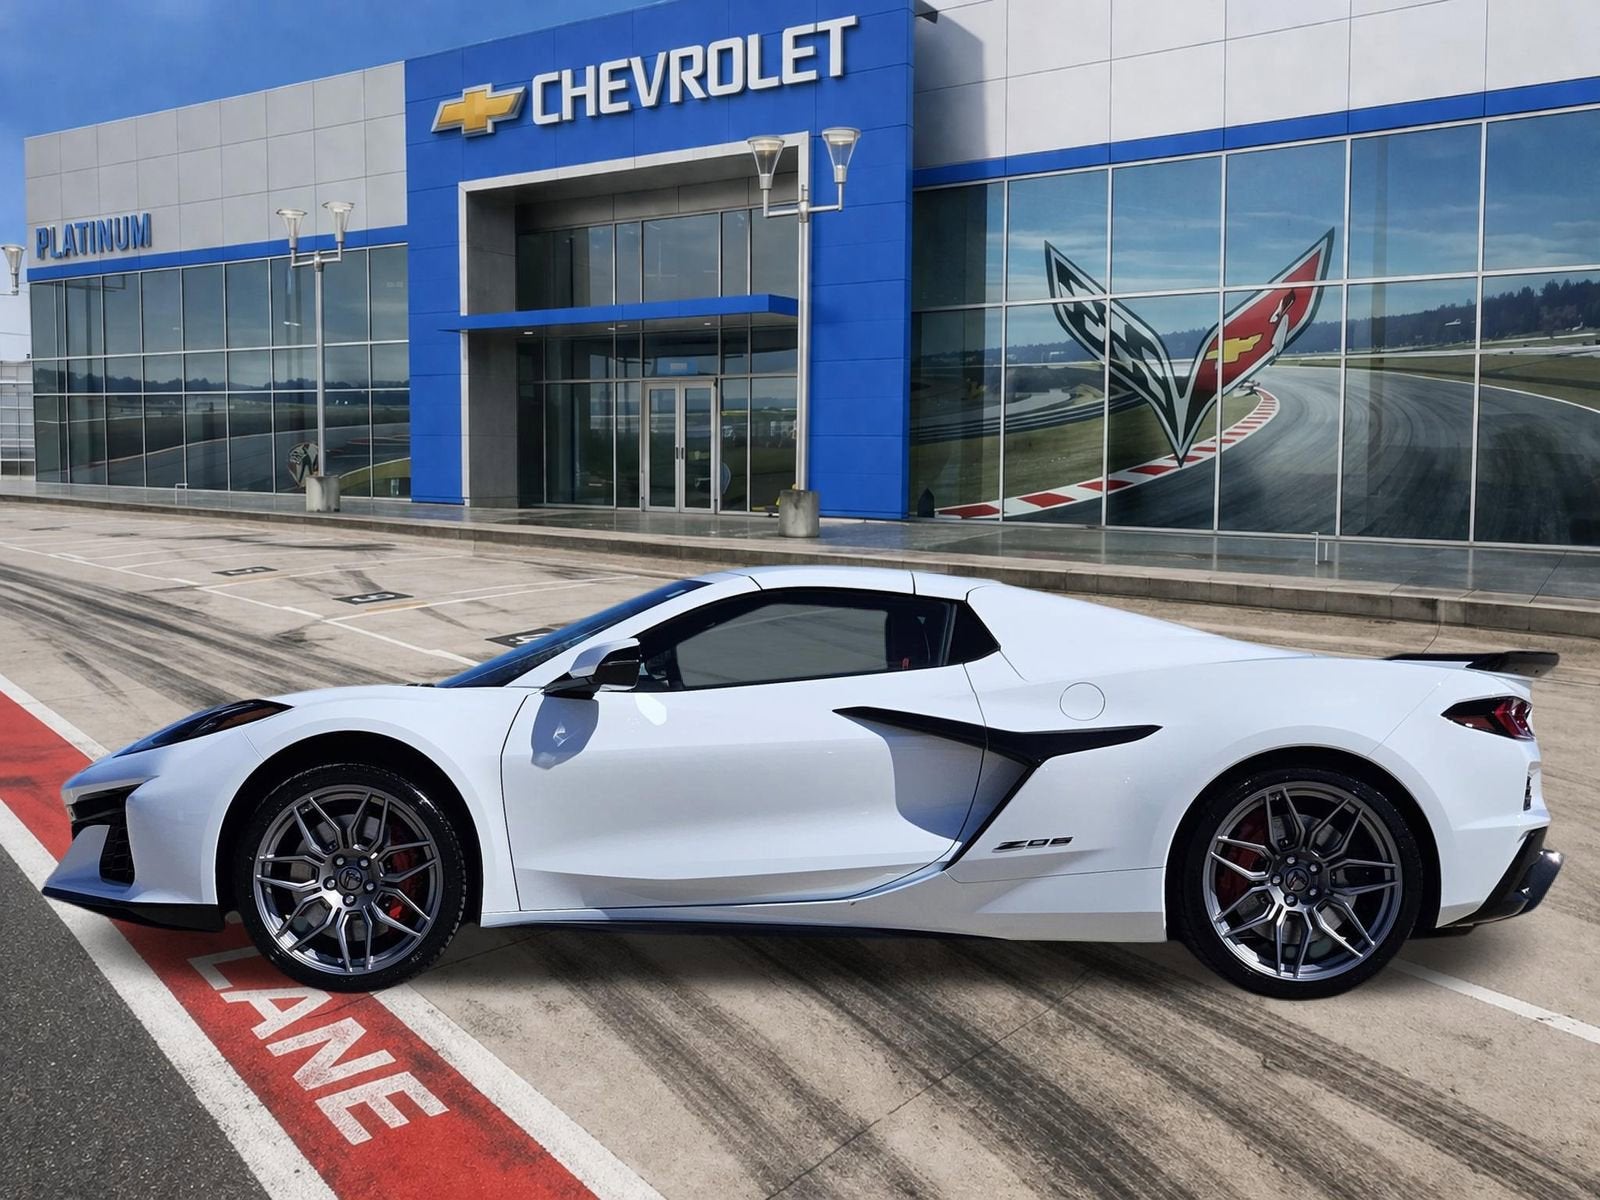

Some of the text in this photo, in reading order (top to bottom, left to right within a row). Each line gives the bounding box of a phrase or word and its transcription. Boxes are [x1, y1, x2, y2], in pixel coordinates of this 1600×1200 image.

[532, 15, 858, 125] CHEVROLET
[36, 213, 152, 259] PLATINUM
[187, 946, 450, 1146] LANE
